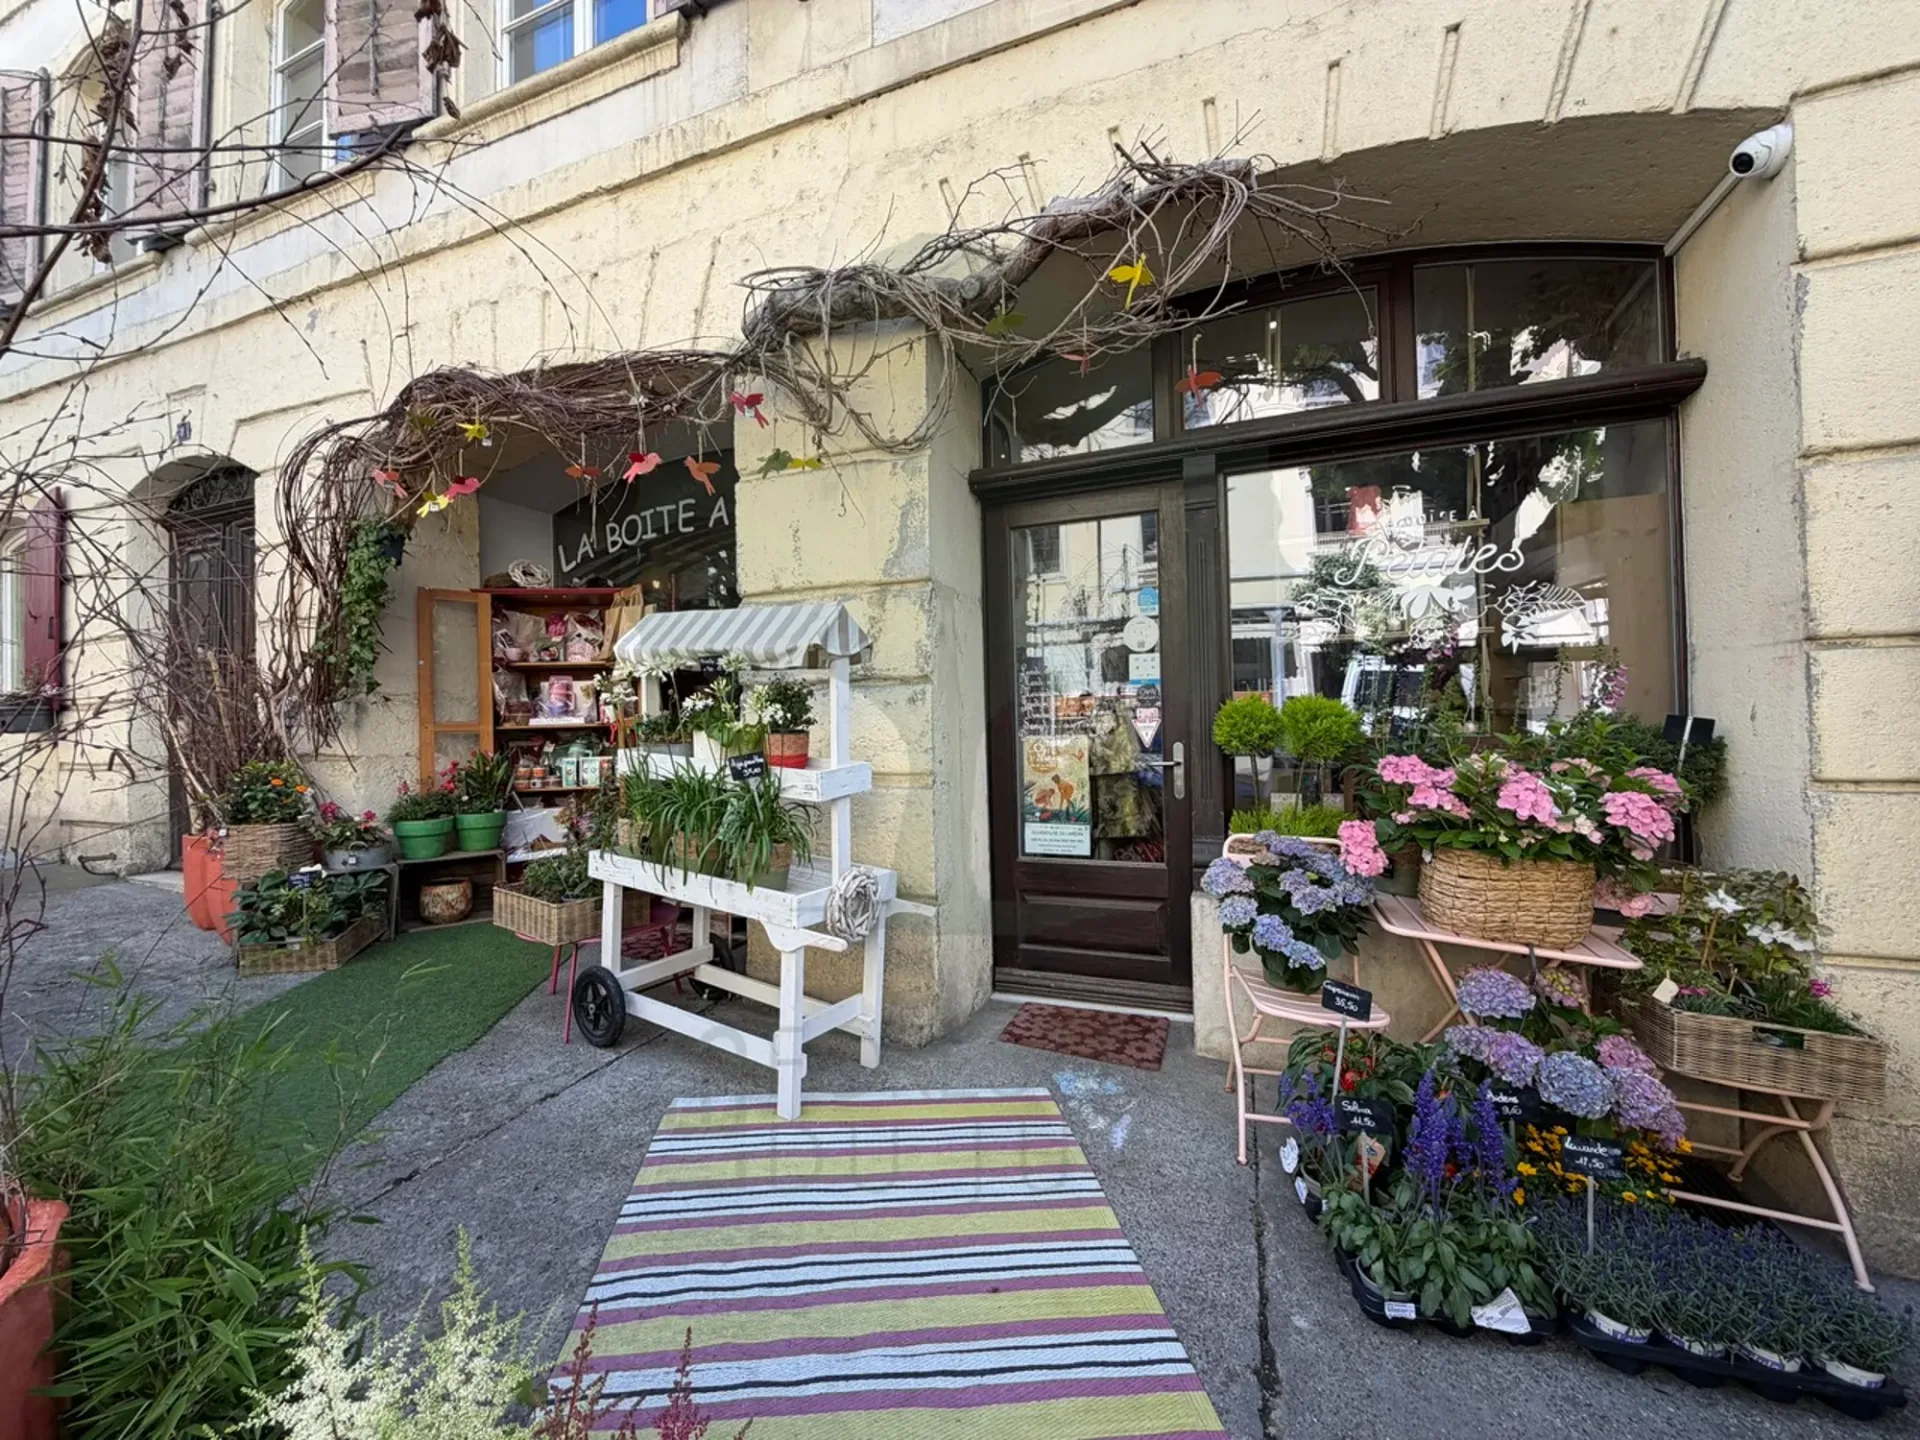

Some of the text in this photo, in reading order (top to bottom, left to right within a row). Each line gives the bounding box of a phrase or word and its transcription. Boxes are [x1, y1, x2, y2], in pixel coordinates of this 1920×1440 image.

[558, 496, 729, 573] LA BOITE A
